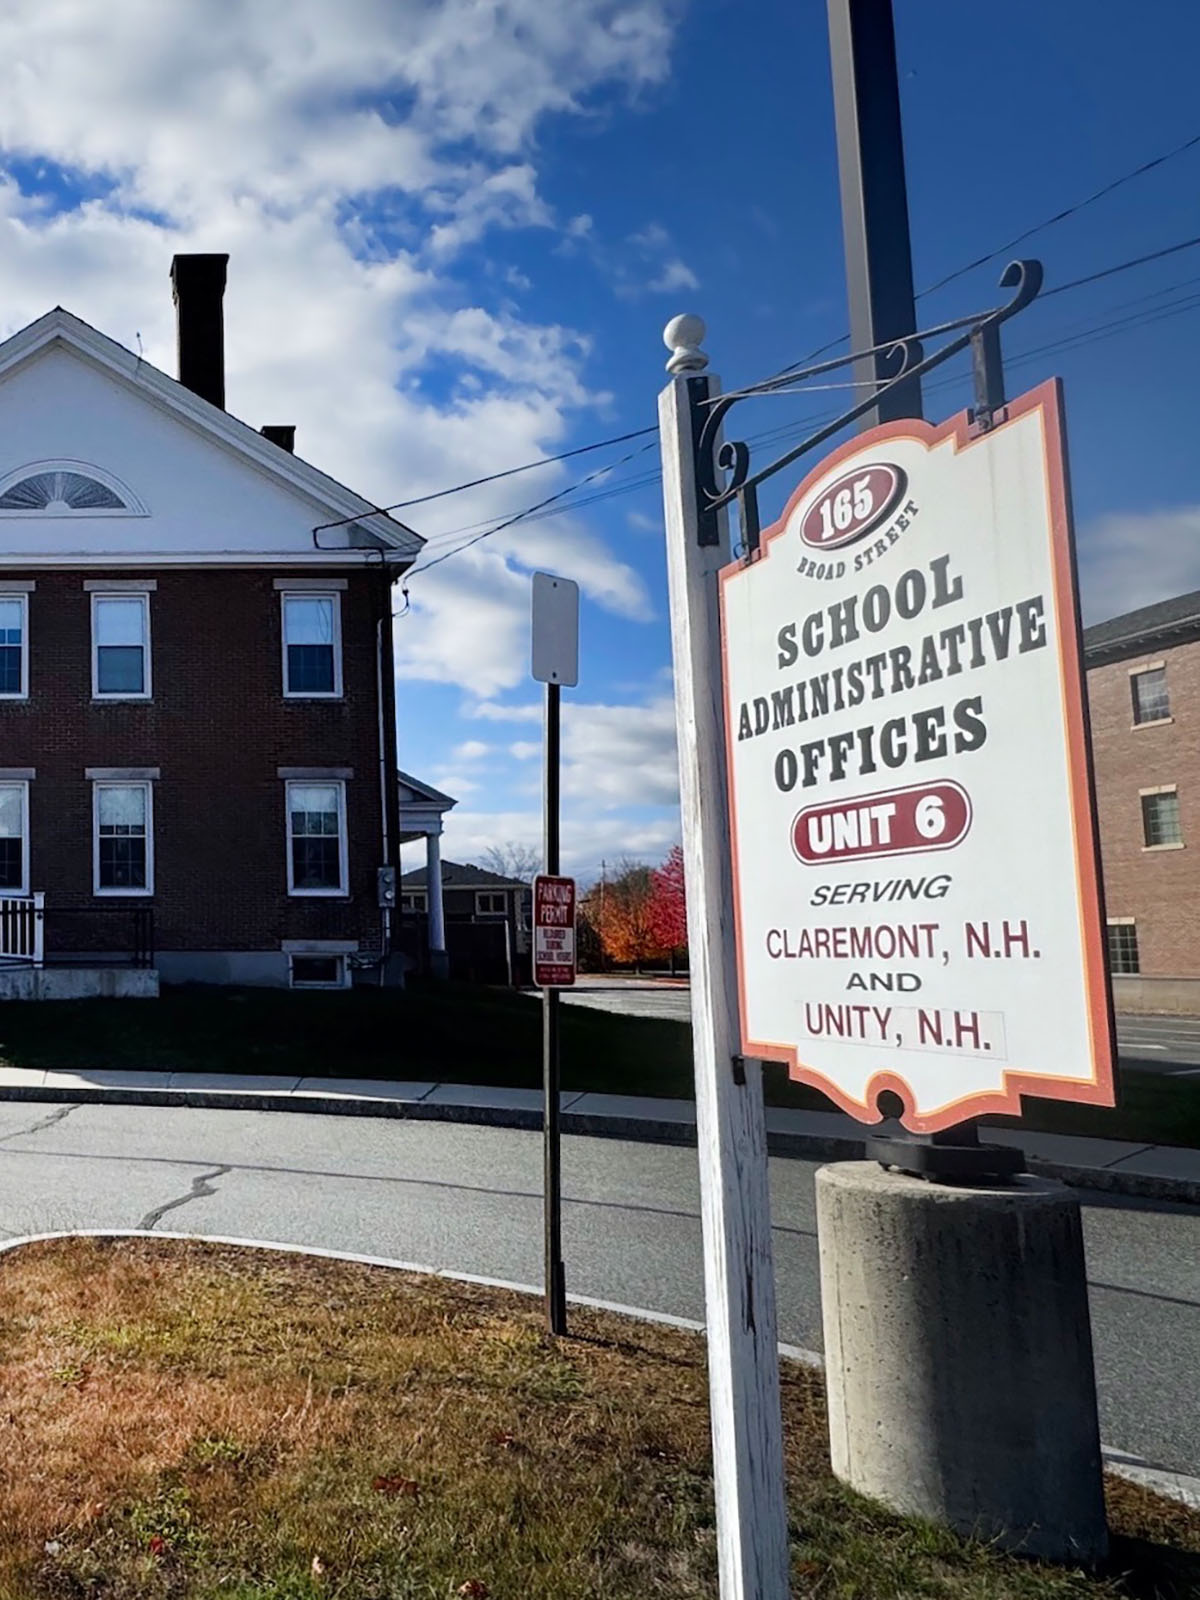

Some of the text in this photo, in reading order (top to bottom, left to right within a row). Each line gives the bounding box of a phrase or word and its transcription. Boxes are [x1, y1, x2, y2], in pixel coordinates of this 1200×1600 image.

[820, 474, 873, 540] 165
[797, 500, 919, 580] BROAD STREET
[777, 553, 963, 670] SCHOOL
[738, 595, 1047, 741] ADMINISTRATIVE
[774, 696, 988, 792] OFFICES
[807, 795, 946, 854] UNIT 6
[538, 882, 572, 903] PARKING
[541, 904, 568, 923] PERMIT
[810, 874, 952, 907] SERVING
[766, 920, 1041, 966] CLAREMONT, N.H.
[846, 972, 922, 992] AND
[805, 1002, 991, 1051] UNITY, N.H.
